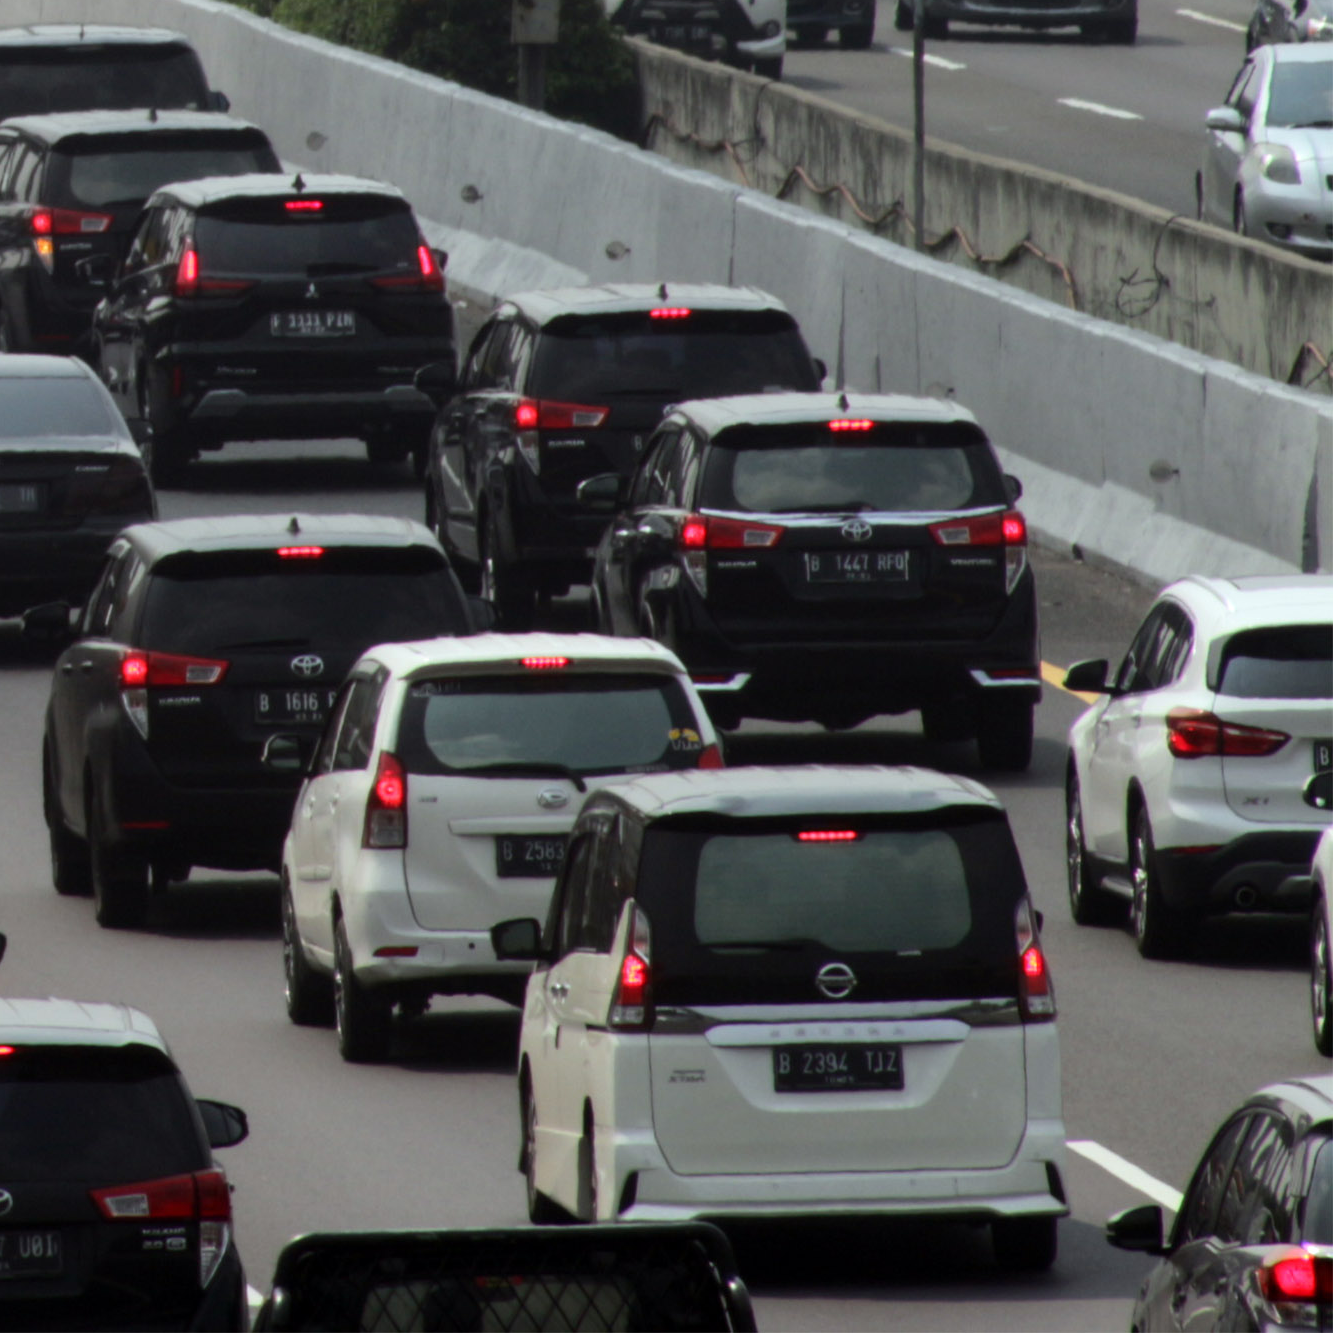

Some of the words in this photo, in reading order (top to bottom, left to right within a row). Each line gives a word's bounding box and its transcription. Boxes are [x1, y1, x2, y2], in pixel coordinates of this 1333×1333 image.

[811, 554, 820, 572] B
[837, 554, 869, 571] 1447
[260, 693, 270, 712] B
[286, 691, 319, 711] 1616
[1320, 745, 1329, 766] B
[503, 840, 513, 862] B
[525, 839, 564, 862] 2583
[779, 1052, 791, 1075] B
[802, 1050, 848, 1075] 2394
